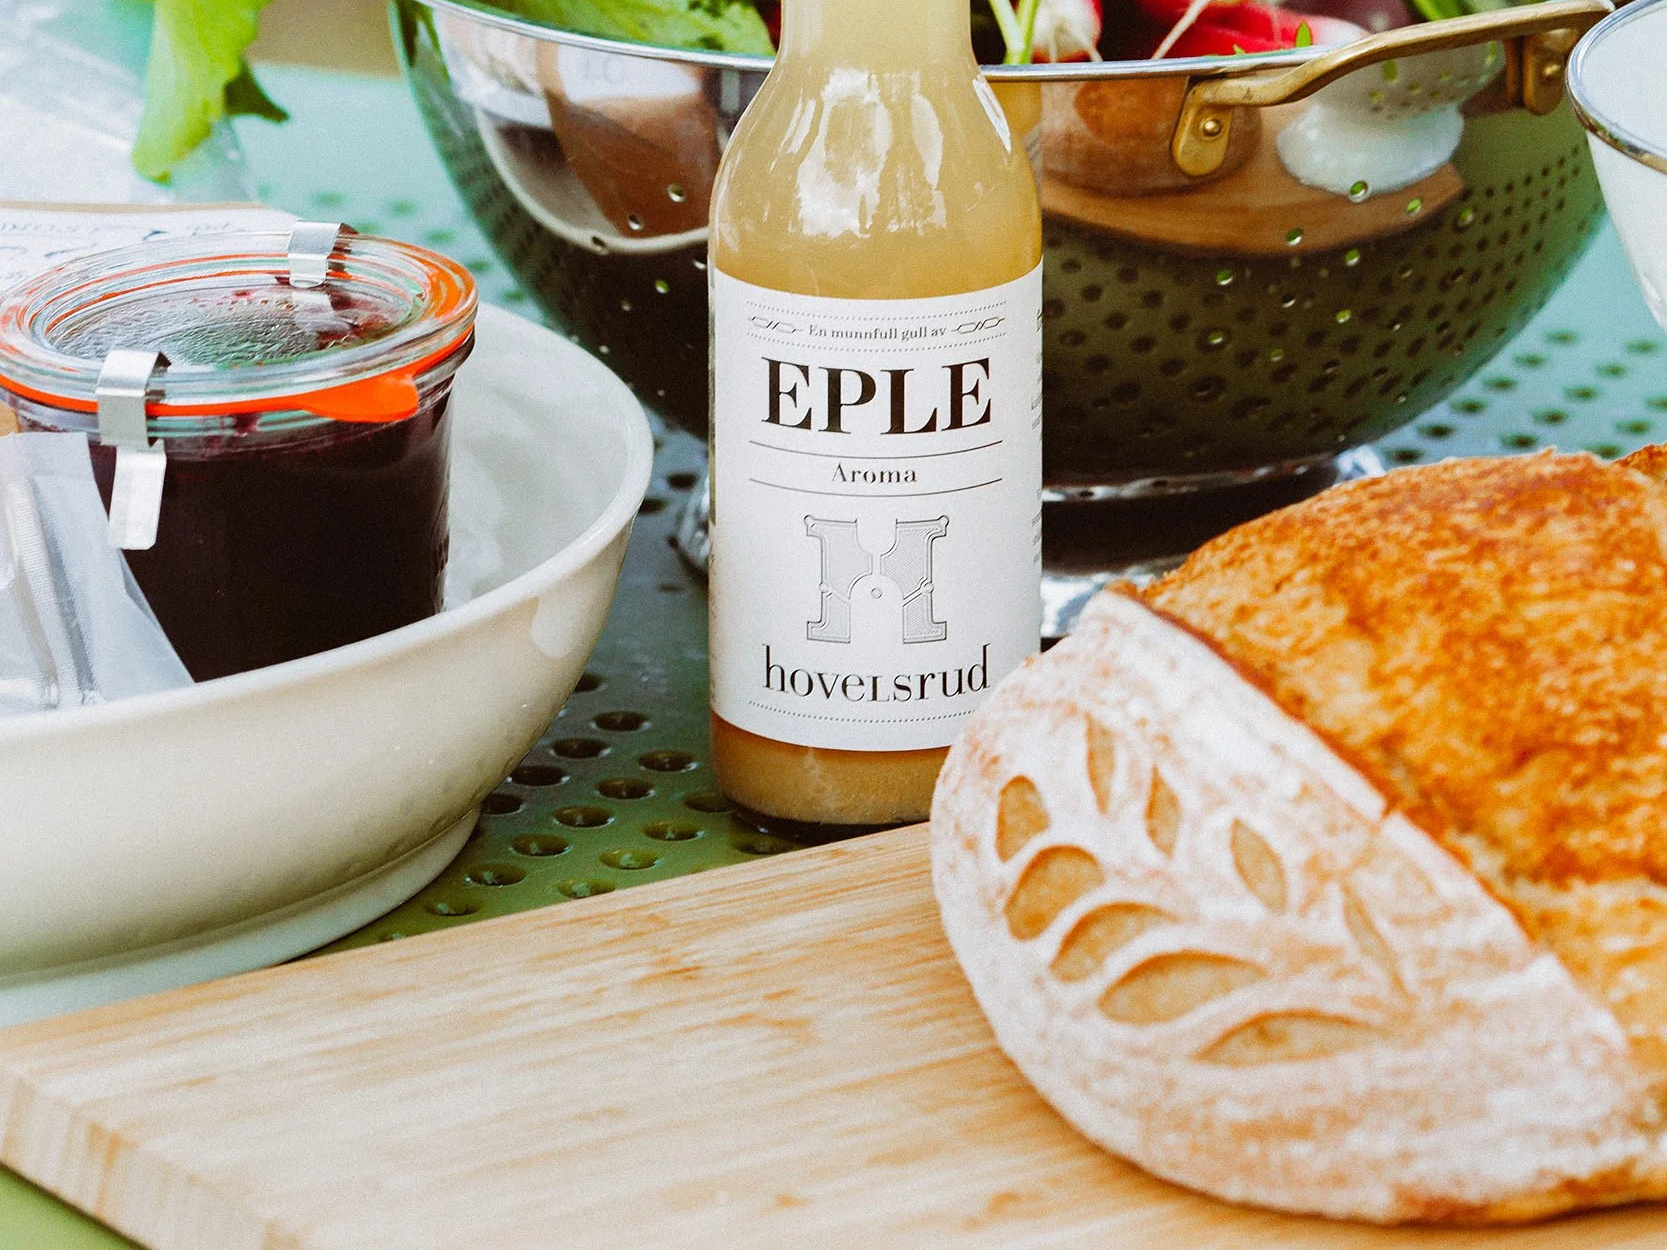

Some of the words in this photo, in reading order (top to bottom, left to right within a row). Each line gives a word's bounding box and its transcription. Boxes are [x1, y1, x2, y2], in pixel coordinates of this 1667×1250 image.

[808, 324, 828, 338] En
[831, 327, 898, 340] munnfull
[901, 326, 928, 342] gull
[931, 327, 947, 338] av
[762, 357, 991, 435] EPLE
[831, 462, 917, 484] Aroma
